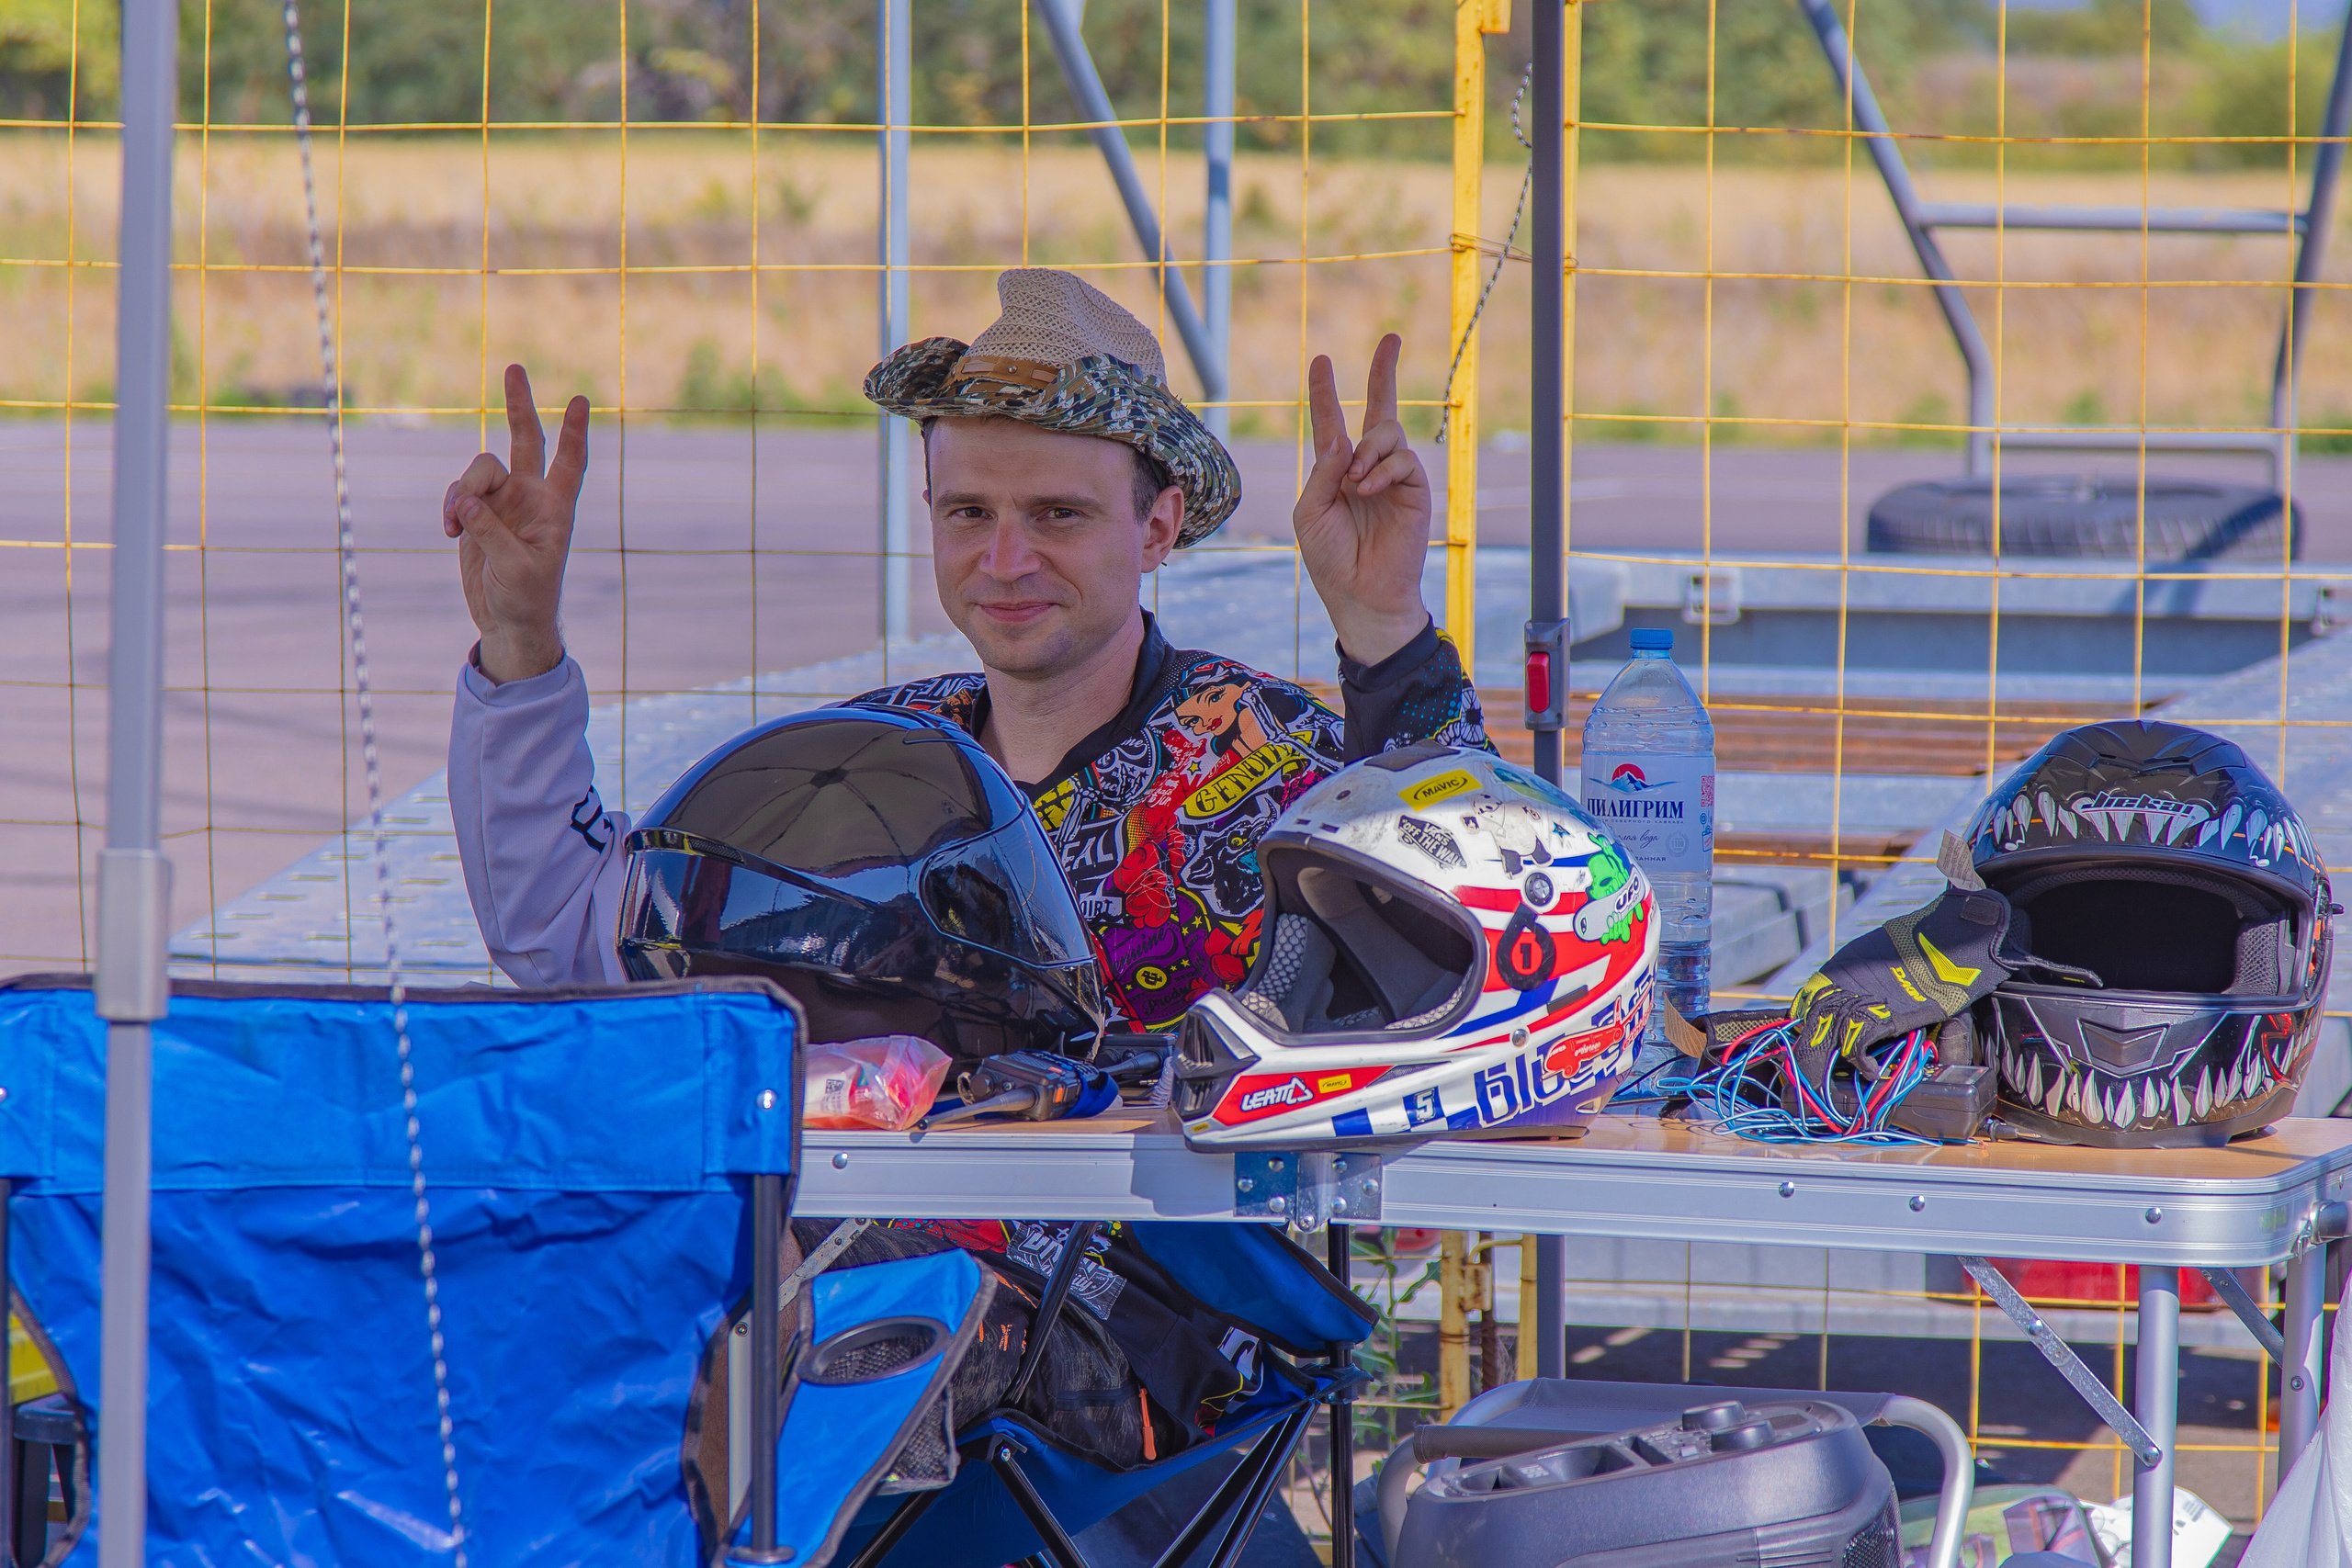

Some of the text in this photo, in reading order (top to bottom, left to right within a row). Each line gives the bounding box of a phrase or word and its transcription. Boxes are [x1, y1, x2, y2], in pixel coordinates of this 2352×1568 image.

[1421, 779, 1461, 798] MAVIC
[1587, 798, 1684, 819] ПИЛИГРИМ
[1418, 832, 1441, 854] THE
[1423, 822, 1450, 846] VANS
[1614, 874, 1640, 911] UFO
[1521, 943, 1532, 970] 1
